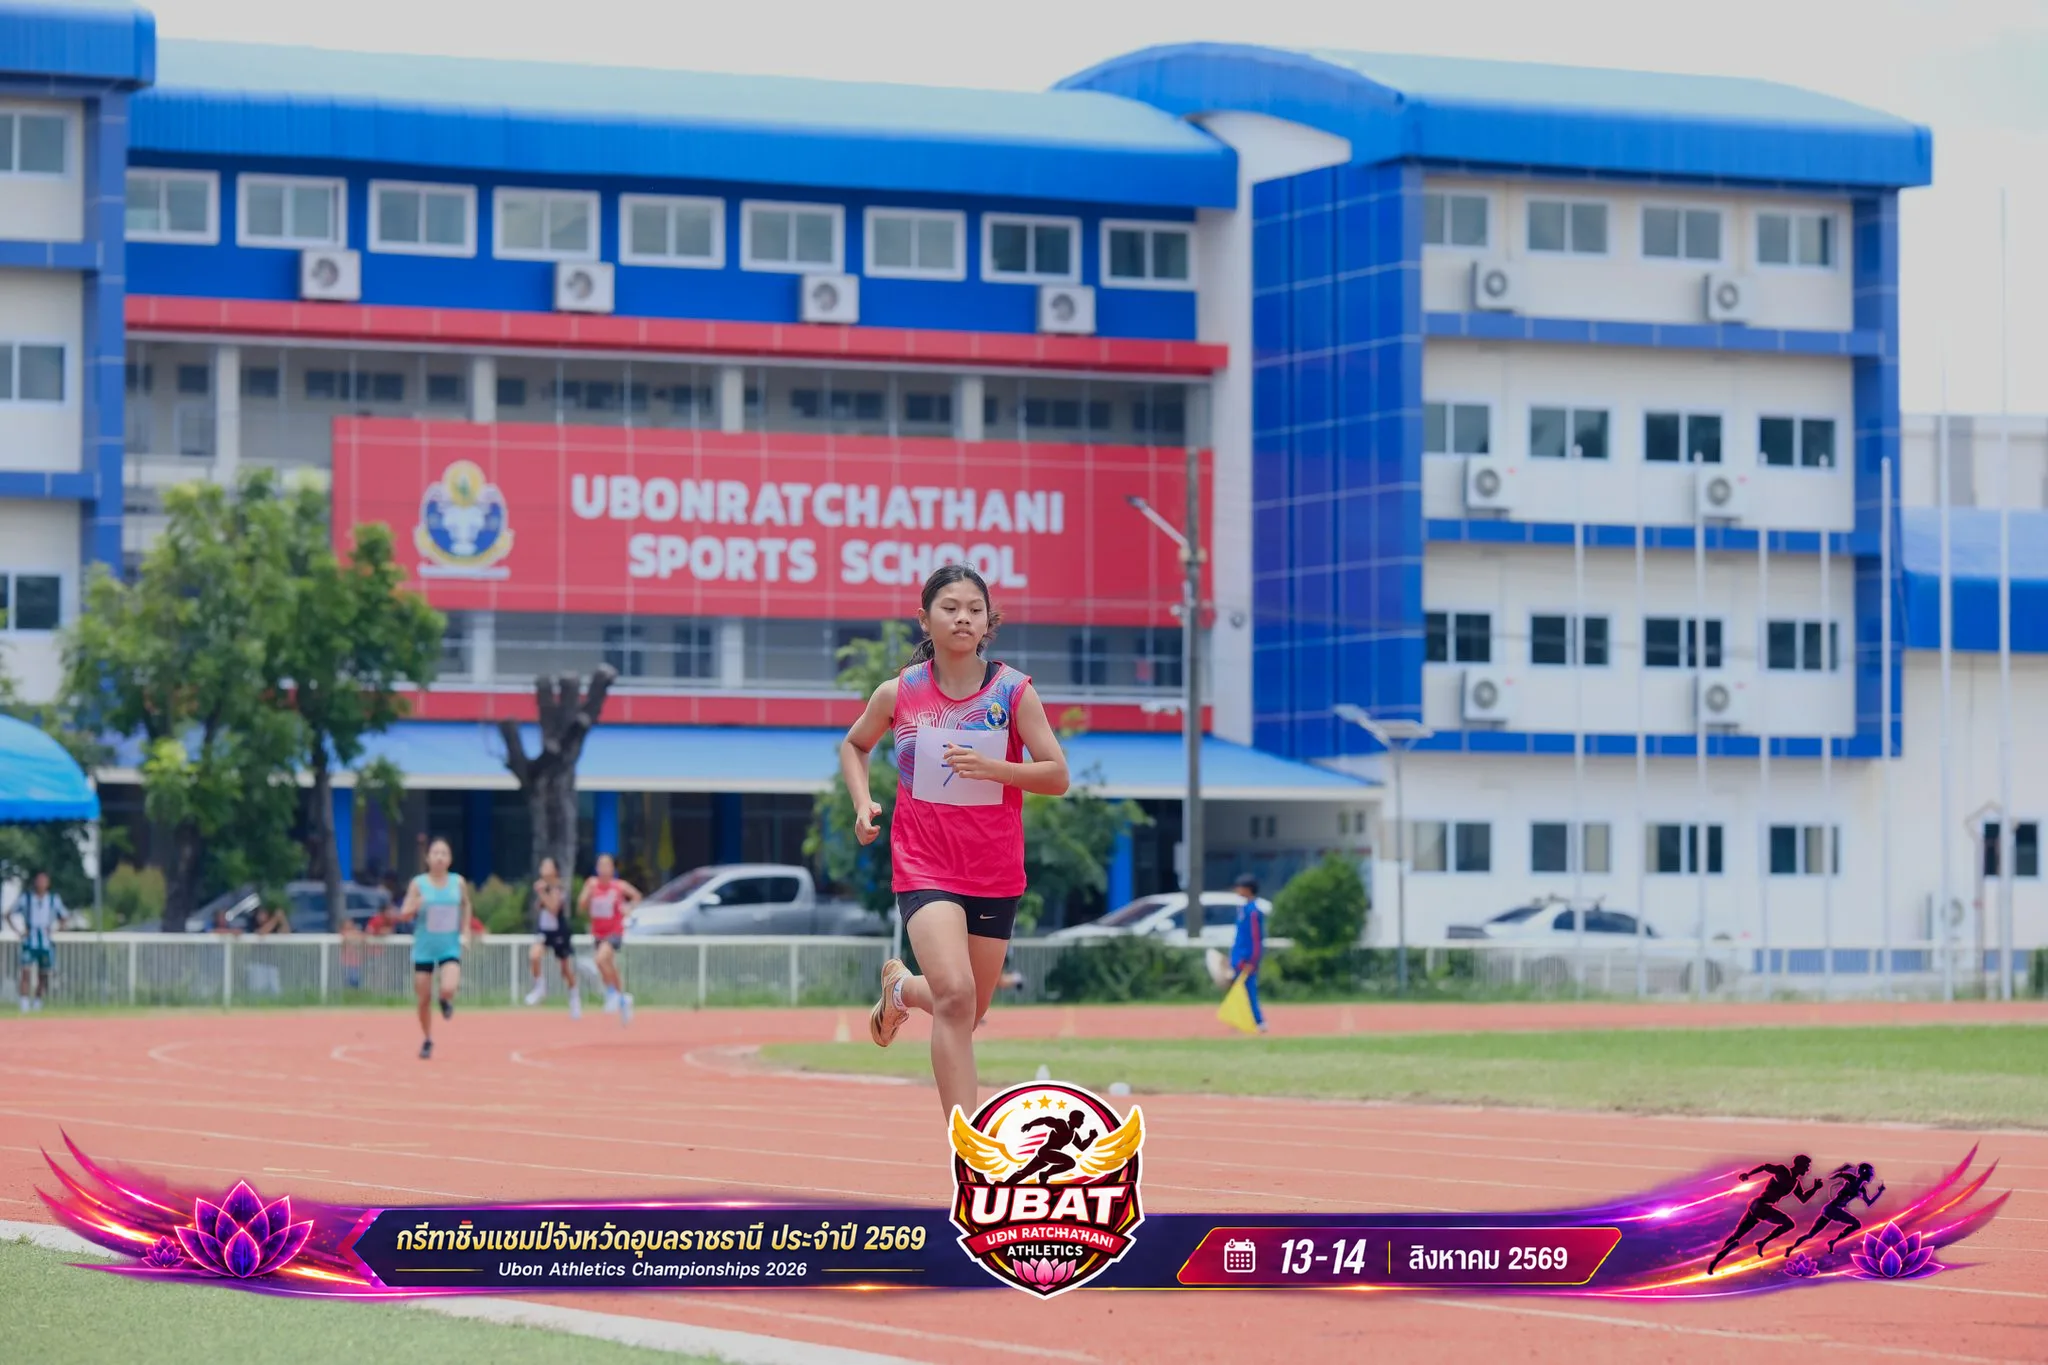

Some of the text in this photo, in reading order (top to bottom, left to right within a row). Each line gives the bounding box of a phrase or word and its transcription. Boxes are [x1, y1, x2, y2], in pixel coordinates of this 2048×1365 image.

[571, 473, 1065, 535] UBONRATCHATHANI
[629, 534, 1027, 588] SPORTS SCHOOL
